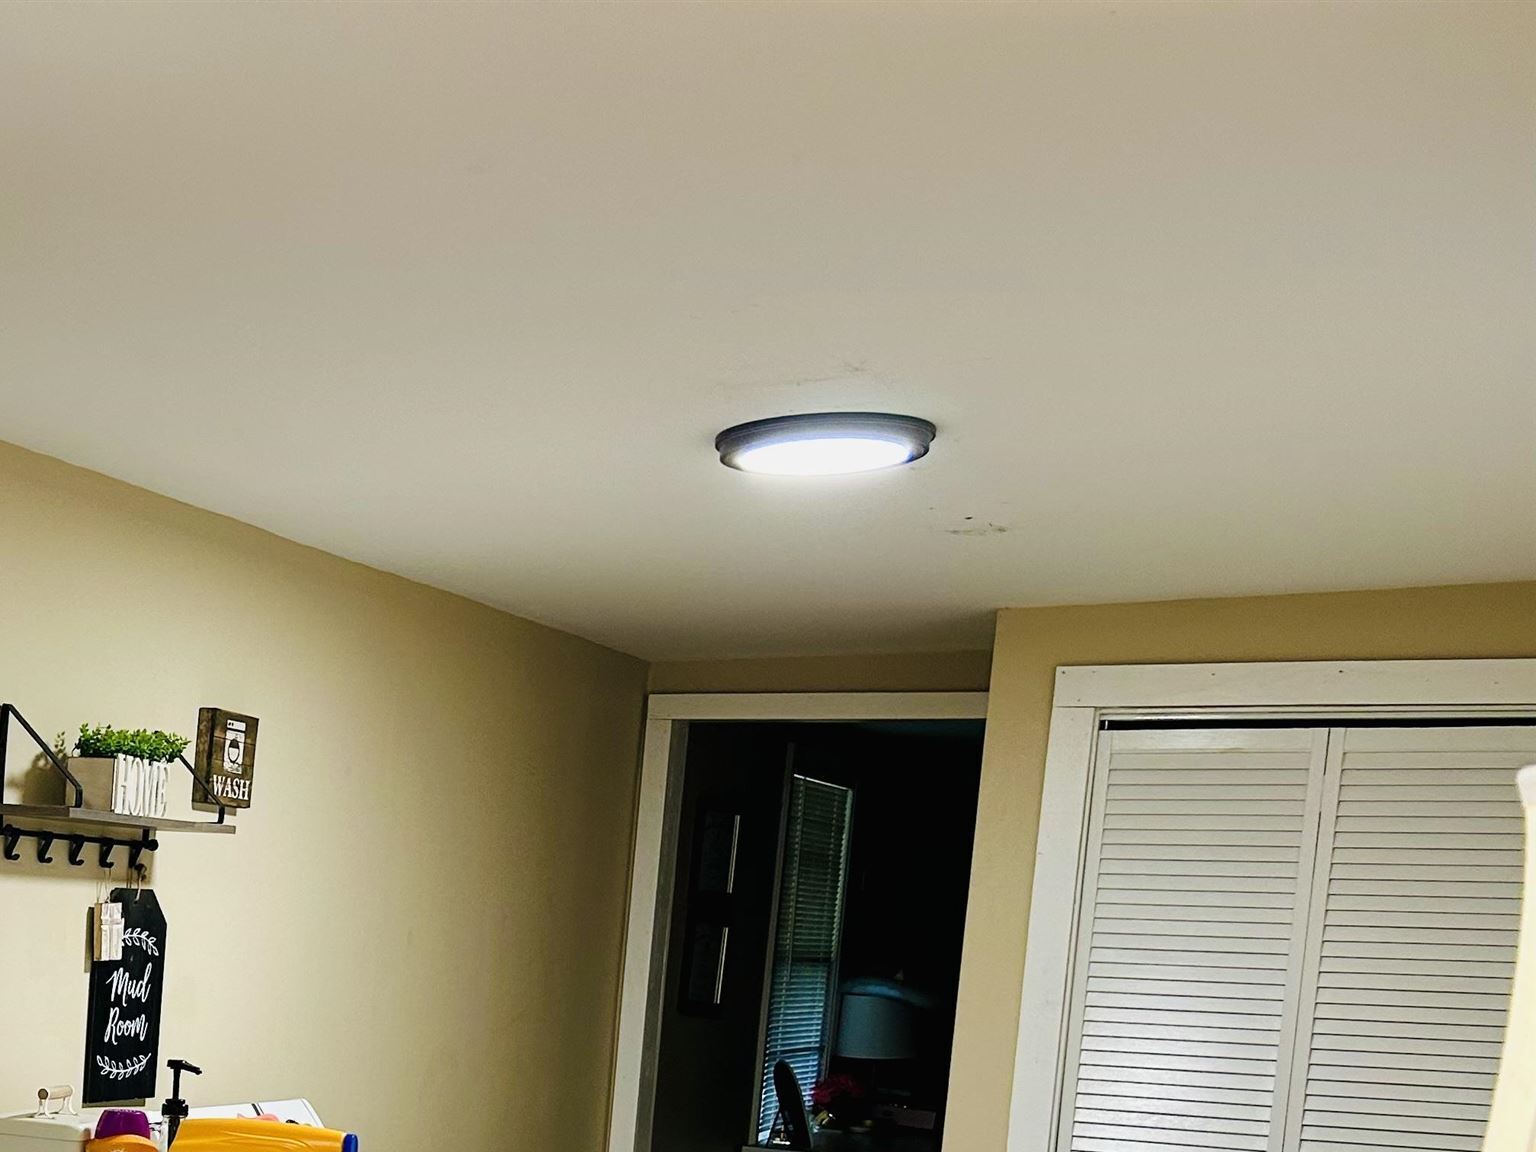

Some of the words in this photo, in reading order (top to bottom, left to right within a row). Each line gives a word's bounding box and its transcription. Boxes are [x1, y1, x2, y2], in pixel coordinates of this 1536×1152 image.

[113, 752, 170, 818] HOME
[212, 773, 251, 801] WASH
[105, 961, 153, 1008] Mud
[104, 1006, 149, 1046] Room
